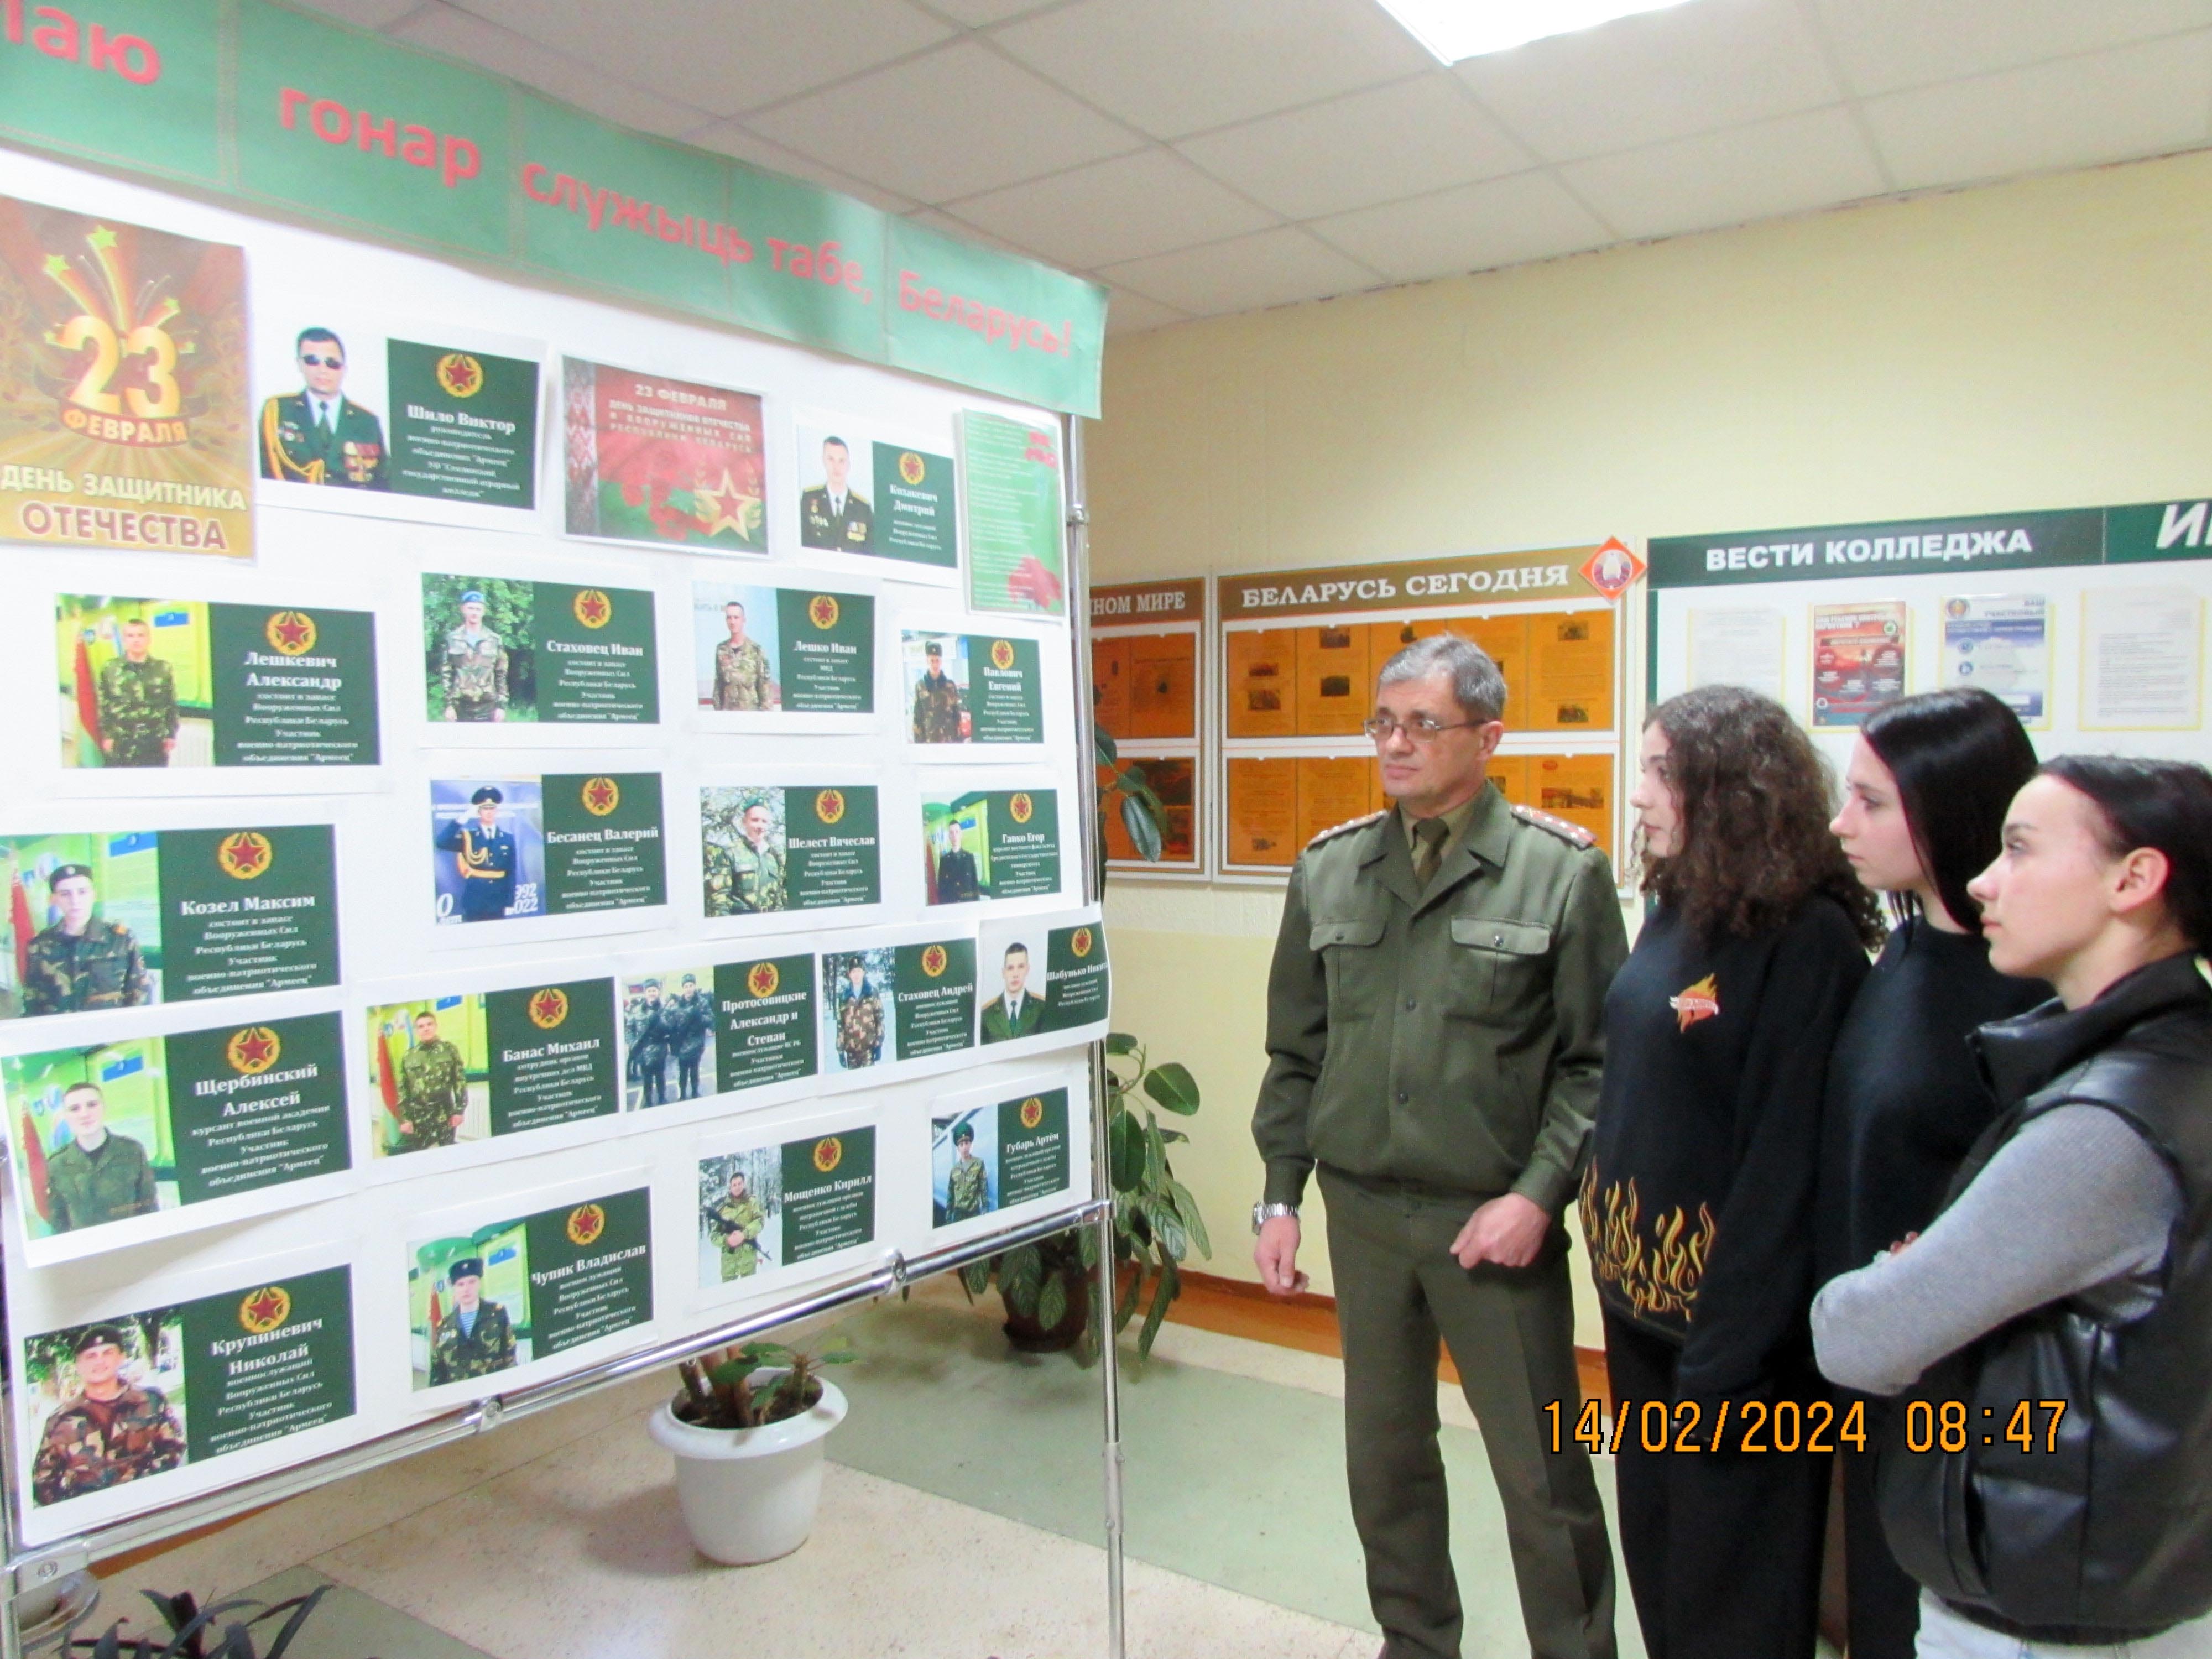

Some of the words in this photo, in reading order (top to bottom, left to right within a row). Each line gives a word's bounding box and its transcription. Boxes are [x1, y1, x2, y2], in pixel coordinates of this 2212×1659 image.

[280, 87, 481, 187] гонар
[521, 162, 753, 268] служыць
[767, 236, 873, 305] табе,
[898, 269, 1071, 357] Беларусь!
[58, 315, 180, 418] 23
[610, 400, 634, 411] ДЕНЬ
[635, 384, 653, 397] 23
[658, 388, 727, 410] ФЕВРАЛЯ
[62, 408, 187, 442] ФЕВРАЛЯ
[407, 404, 454, 423] Шило
[458, 413, 515, 435] Виктор
[0, 465, 75, 493] ДЕНЬ
[83, 472, 247, 510] ЗАЩИТНИКА
[893, 500, 935, 516] Дмитрий
[22, 501, 228, 550] ОТЕЧЕСТВА
[2156, 502, 2212, 549] И
[1705, 544, 1814, 572] ВЕСТИ
[1825, 529, 2033, 564] КОЛЛЕДЖА
[1241, 577, 1396, 608] БЕЛАРУСЬ
[1406, 564, 1569, 601] СЕГОДНЯ
[1136, 591, 1186, 612] МИРЕ
[547, 640, 609, 655] Стаховец
[611, 644, 643, 656] Иван
[831, 643, 857, 654] Иван
[244, 651, 337, 667] Лешкевич
[246, 672, 342, 691] Александр
[989, 681, 1021, 691] Евгений
[547, 831, 602, 844] Бесанец
[604, 826, 658, 843] Валерий
[789, 838, 828, 848] Шелест
[830, 836, 875, 847] Вячеслав
[1003, 834, 1025, 843] Гапко
[1027, 833, 1045, 843] Егор
[180, 900, 239, 915] Козел
[243, 895, 315, 911] Максим
[195, 943, 259, 955] Республики
[260, 940, 307, 950] Беларусь
[228, 956, 278, 965] Участник
[1047, 967, 1086, 981] Шабунько
[722, 992, 807, 1014] Протосовицкие
[898, 988, 939, 1002] Стаховец
[942, 983, 973, 995] Андрей
[730, 1014, 789, 1031] Александр
[791, 1011, 798, 1020] и
[747, 1032, 786, 1046] Степан
[503, 1047, 544, 1062] Банас
[547, 1039, 600, 1056] Михаил
[194, 1063, 318, 1097] Щербинский
[222, 1091, 301, 1117] Алексей
[191, 1123, 234, 1136] курсант
[208, 1129, 270, 1146] Республики
[272, 1121, 318, 1134] Беларусь
[240, 1140, 289, 1154] Участник
[1006, 1140, 1034, 1154] Губарь
[1036, 1133, 1059, 1146] Артём
[208, 1167, 277, 1186] объединения
[784, 1184, 832, 1203] Мощенко
[834, 1175, 872, 1191] Кирилл
[531, 1265, 574, 1286] Чупик
[576, 1244, 646, 1272] Владислав
[212, 1318, 322, 1356] Крупиневич
[229, 1343, 309, 1375] Николай
[226, 1377, 295, 1401] Вооруженных
[297, 1370, 315, 1380] Сил
[217, 1395, 278, 1416] Республики
[280, 1381, 323, 1399] Беларусь
[249, 1402, 295, 1420] Участник
